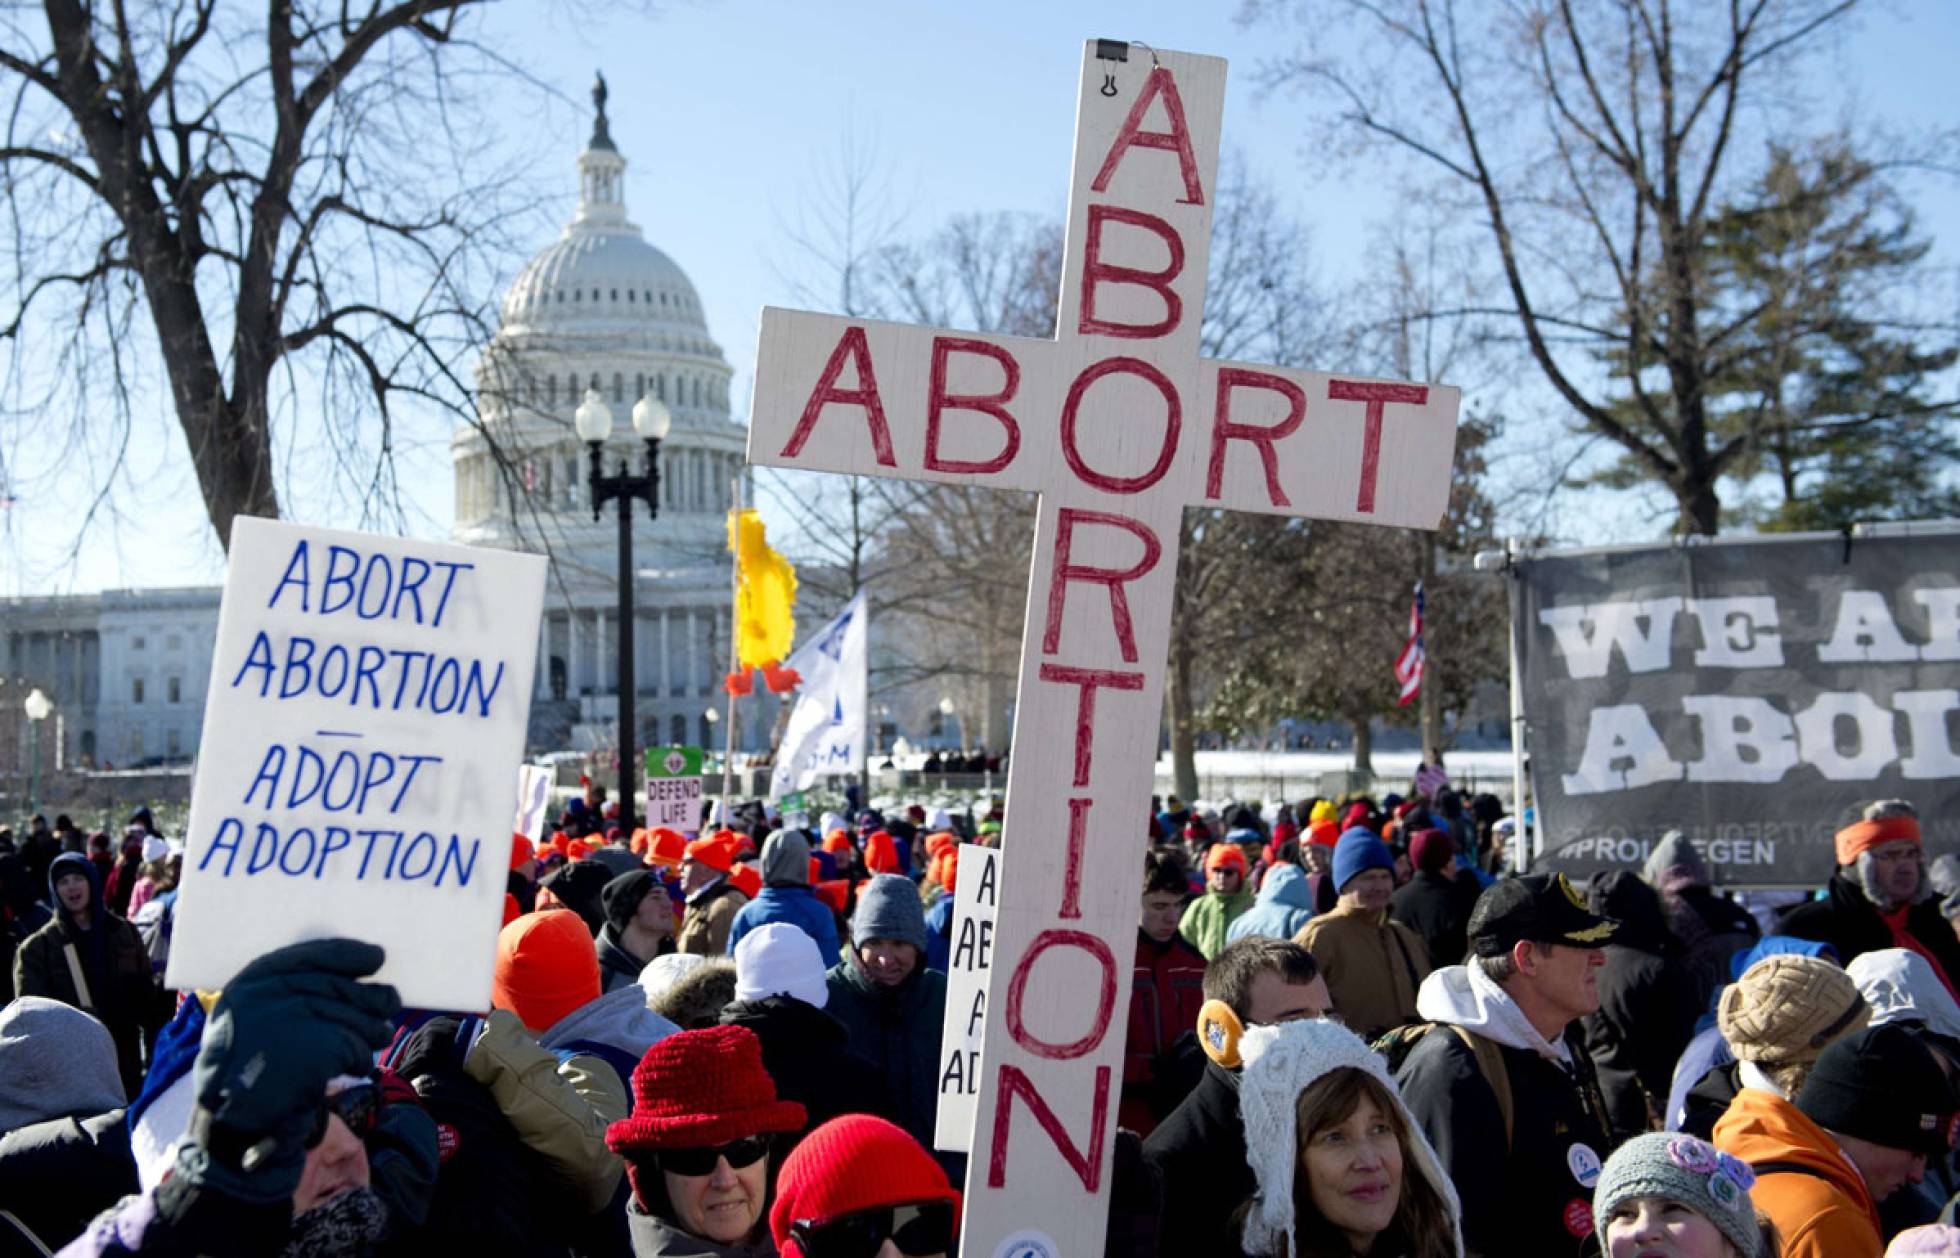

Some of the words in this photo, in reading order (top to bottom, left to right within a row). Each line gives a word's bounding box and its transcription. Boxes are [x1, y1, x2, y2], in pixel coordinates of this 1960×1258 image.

[779, 326, 1429, 513] ABORT
[268, 539, 475, 628] ABORT
[987, 67, 1204, 1195] ABORTION
[1539, 596, 1785, 679] WE
[232, 630, 504, 718] ABORTION
[244, 744, 443, 815] ADOPT
[647, 780, 701, 801] DEFEND
[660, 802, 688, 824] LIFE
[198, 817, 481, 888] ADOPTION
